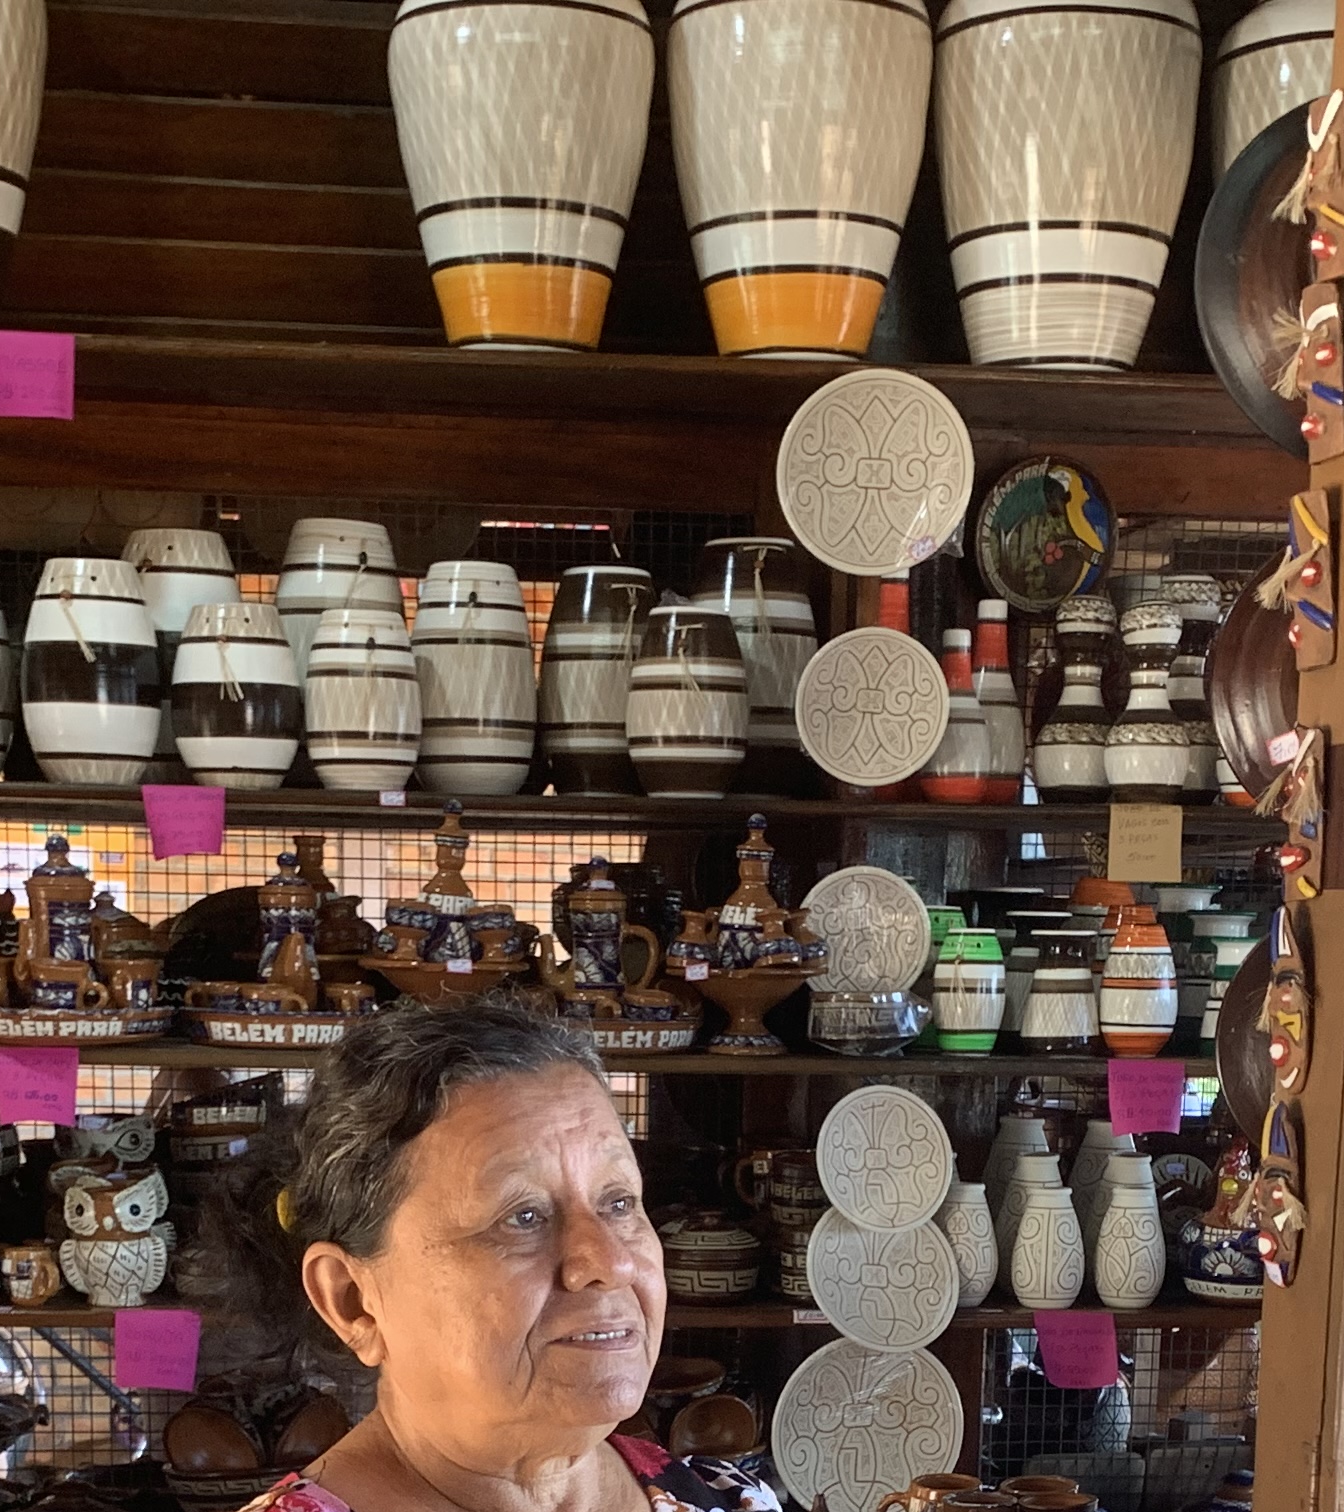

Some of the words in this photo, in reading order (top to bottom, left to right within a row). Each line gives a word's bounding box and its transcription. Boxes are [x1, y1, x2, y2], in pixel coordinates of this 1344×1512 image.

[58, 1016, 123, 1037] PARÁ
[209, 1019, 285, 1043] BELÉM
[592, 1026, 655, 1048] ELÉM
